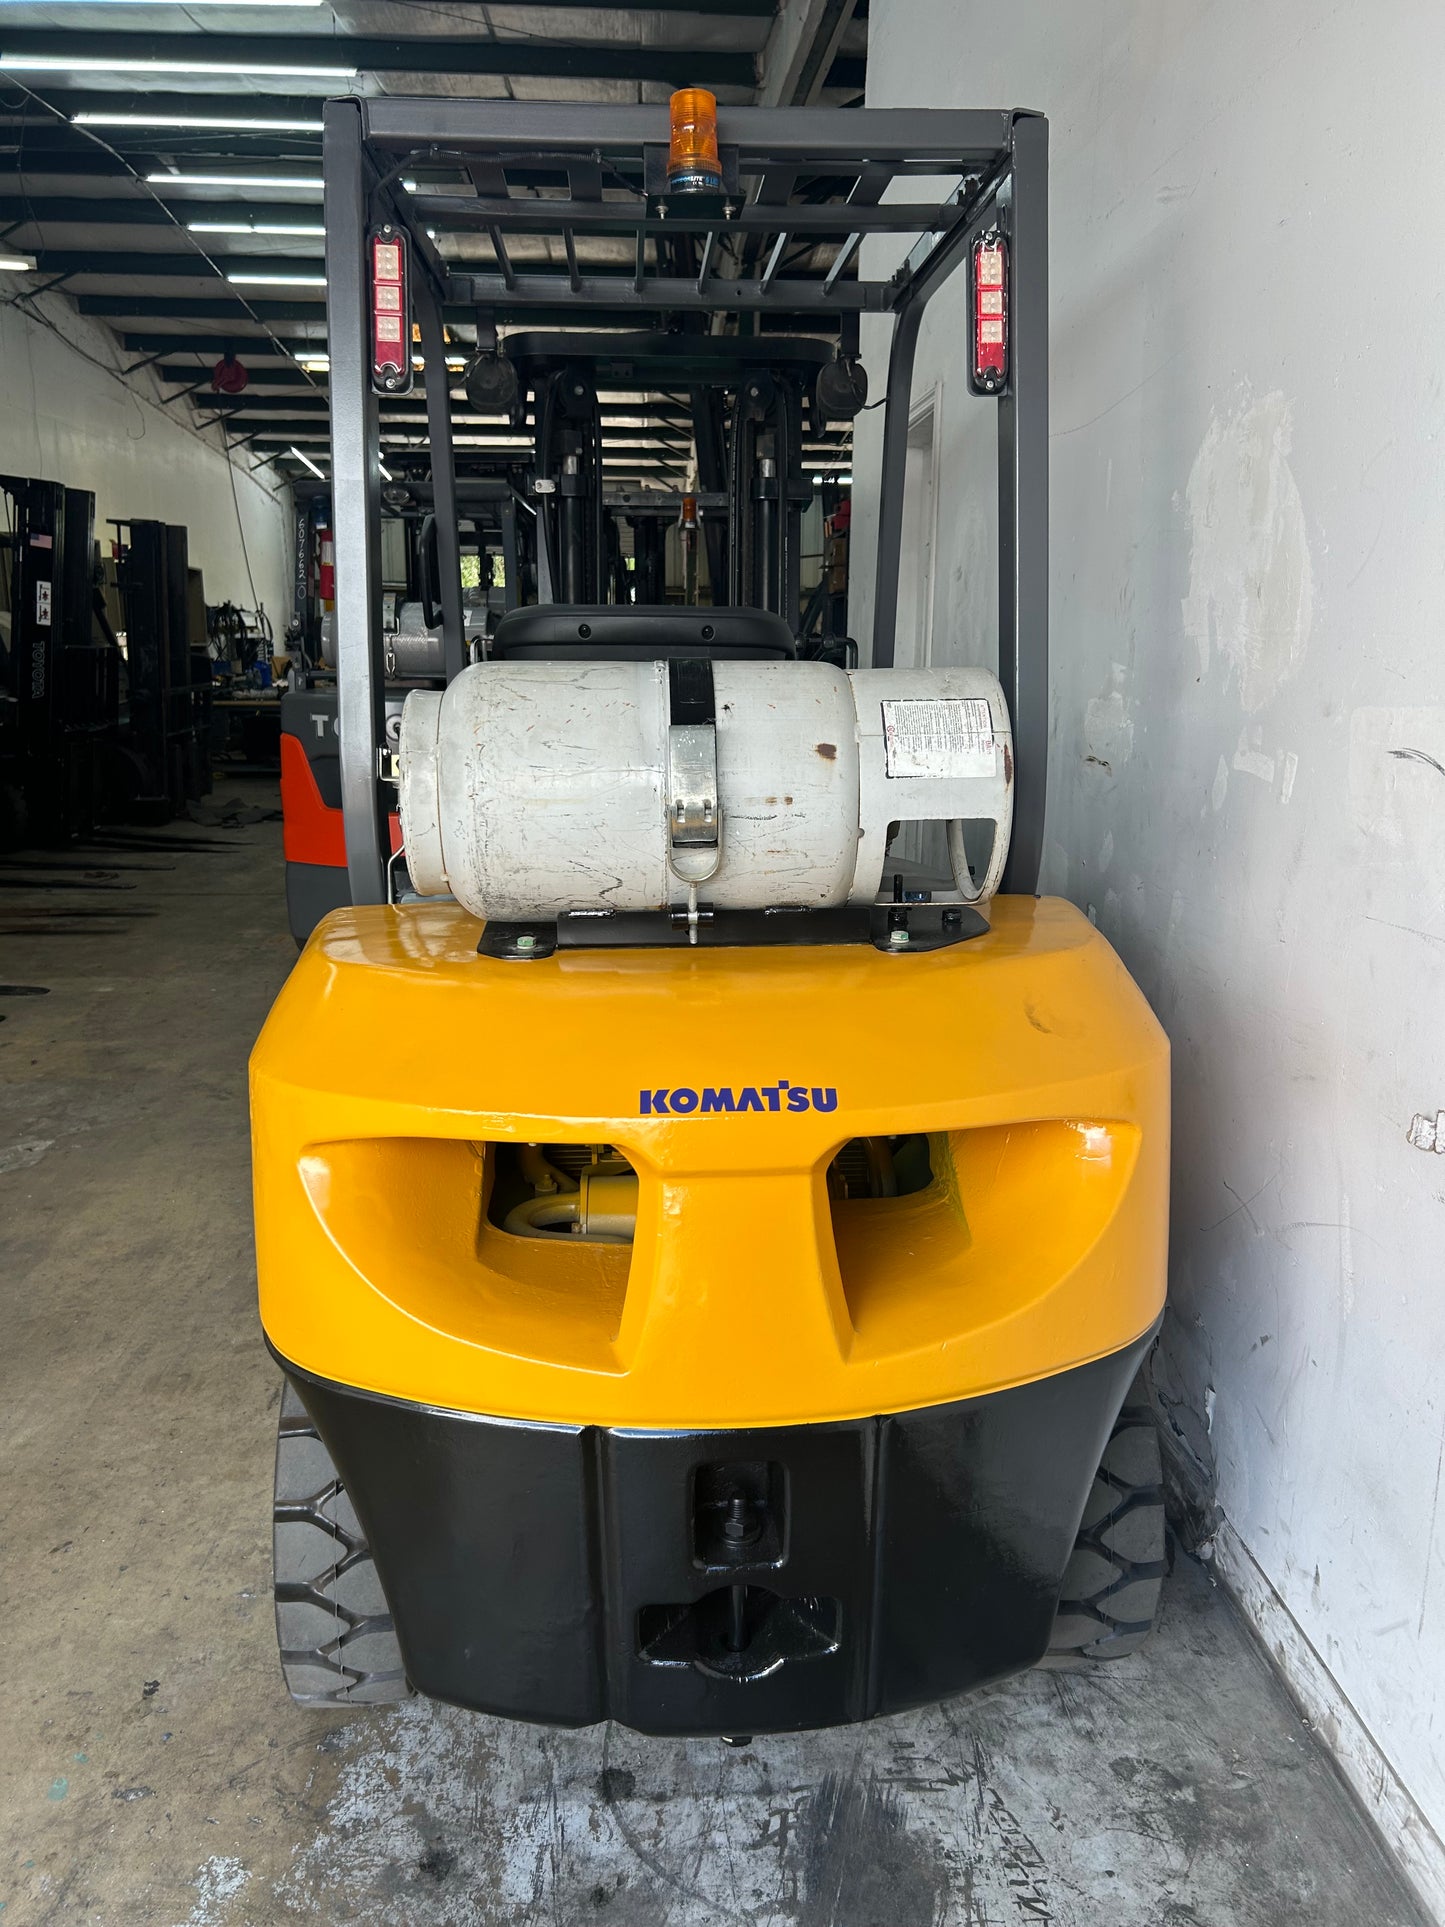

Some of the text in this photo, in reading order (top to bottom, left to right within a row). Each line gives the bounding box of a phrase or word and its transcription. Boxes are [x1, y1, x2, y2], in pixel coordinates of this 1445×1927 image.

[31, 640, 46, 699] TOYOTA
[311, 714, 340, 737] T
[639, 1080, 838, 1114] KOMATSU
